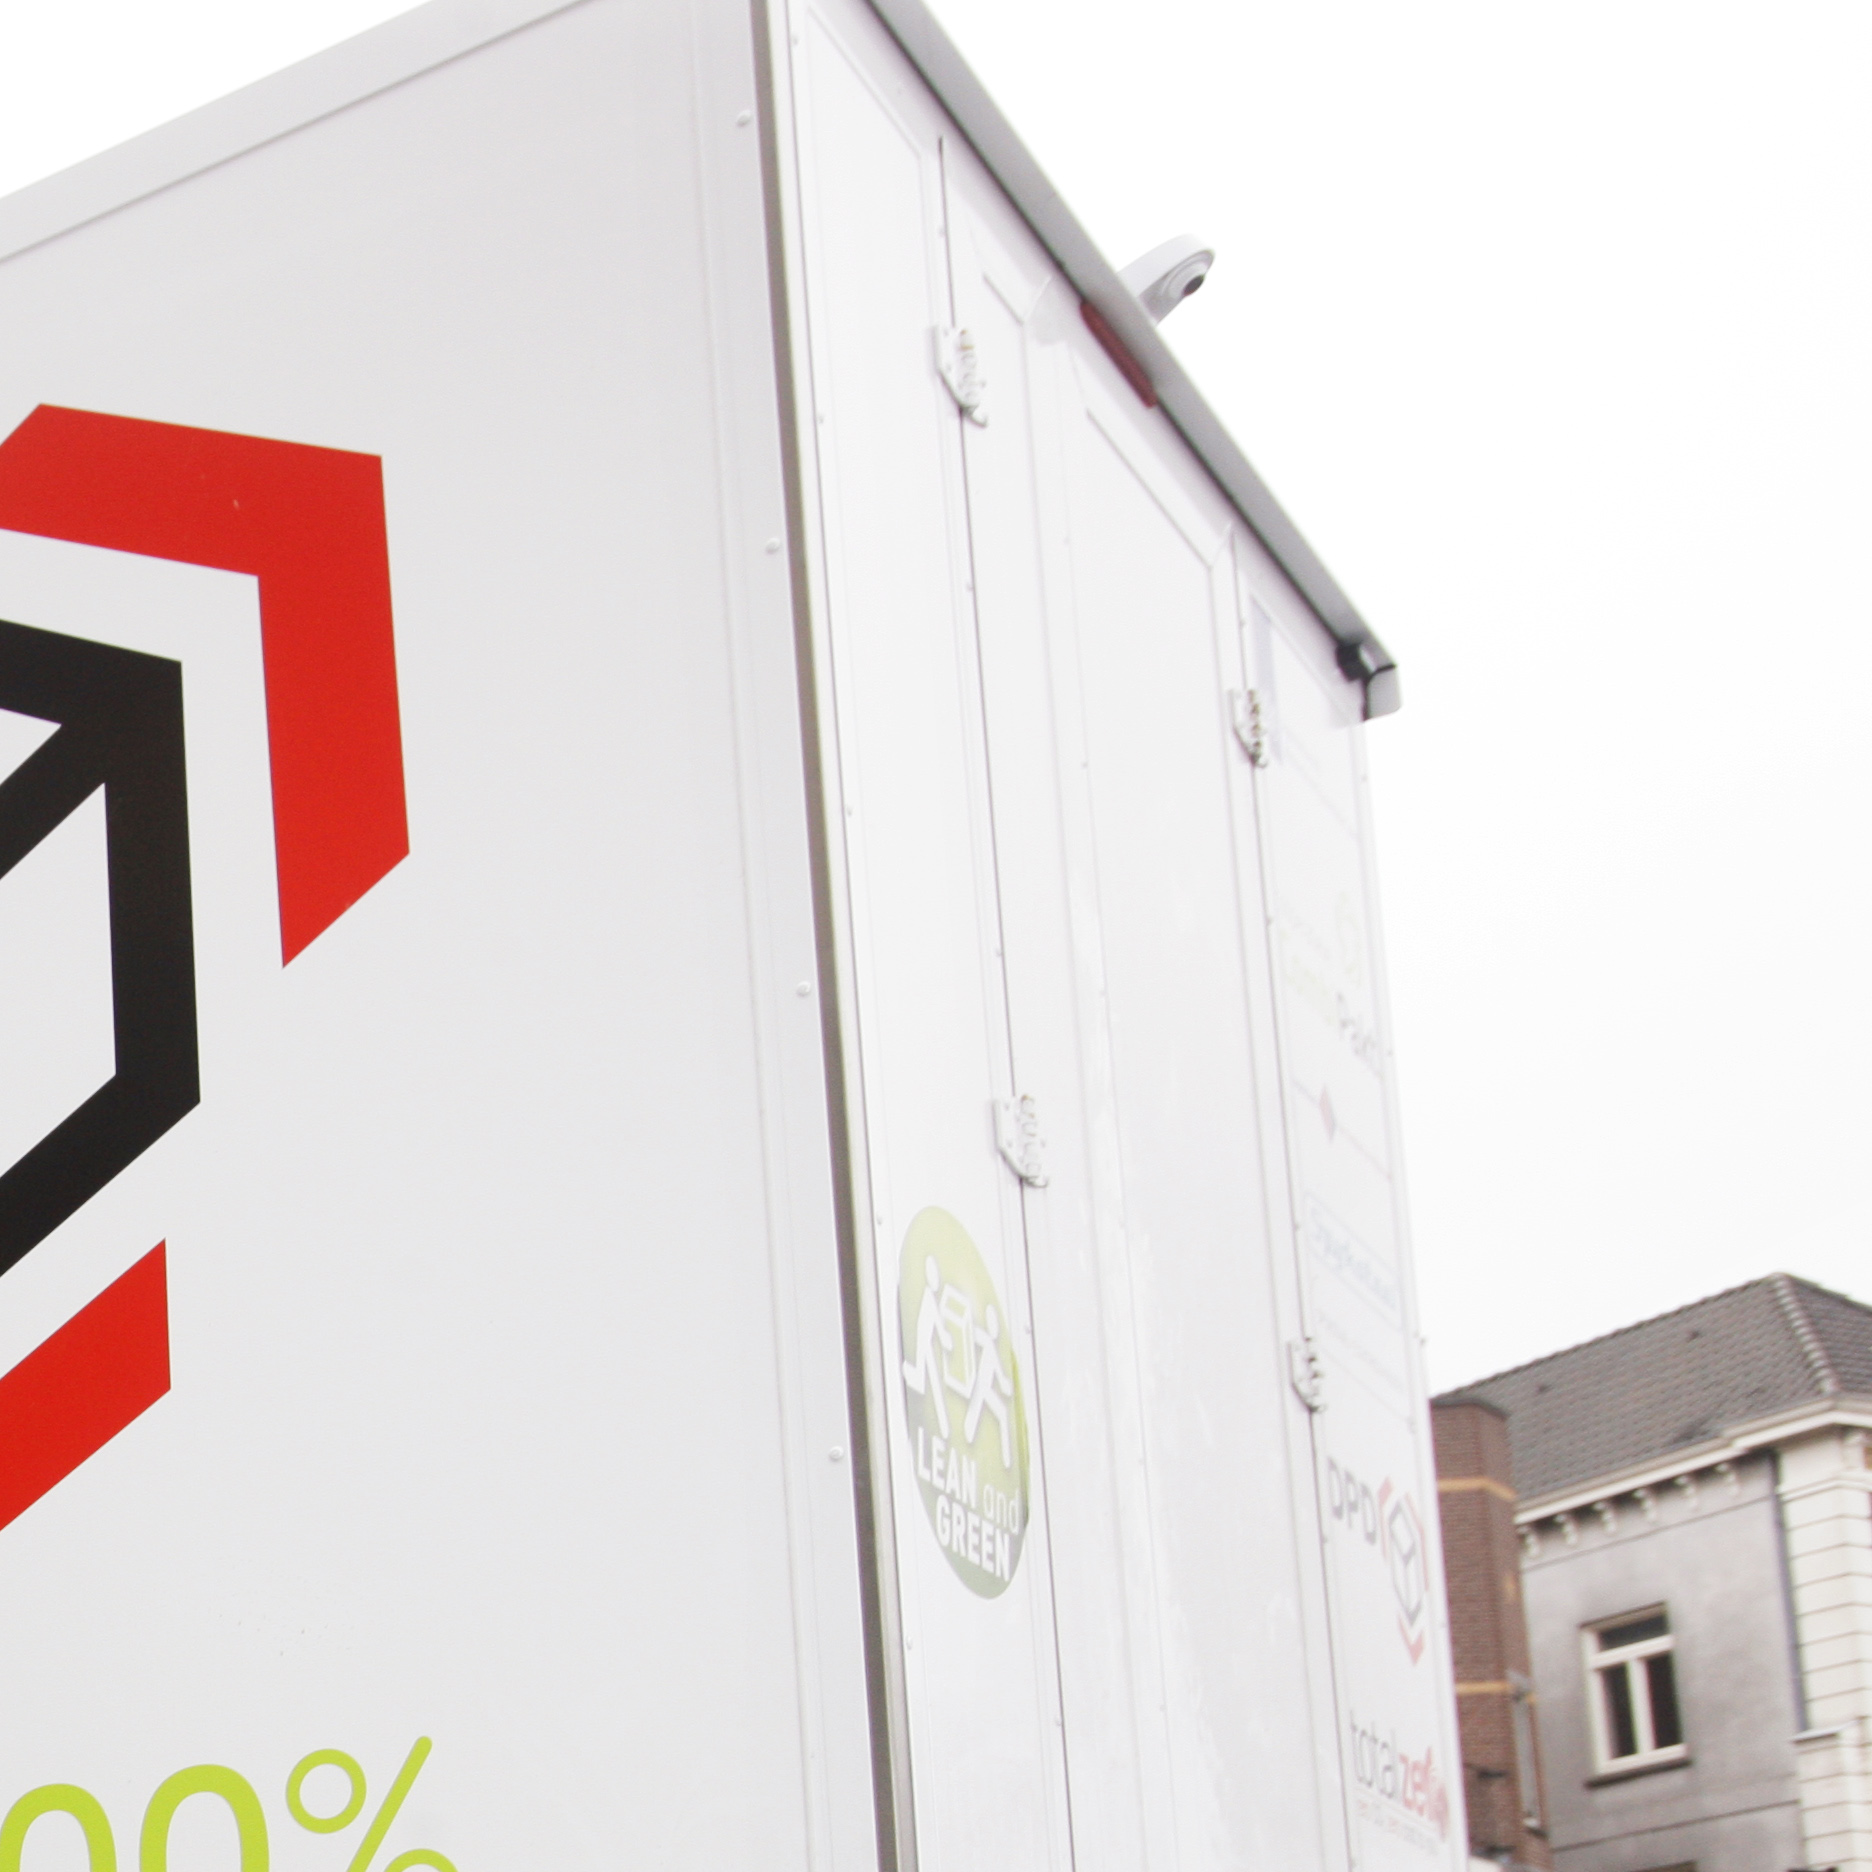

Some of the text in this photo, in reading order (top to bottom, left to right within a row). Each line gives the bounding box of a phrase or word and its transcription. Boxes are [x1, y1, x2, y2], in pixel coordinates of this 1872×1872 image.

[917, 1425, 1020, 1536] LEAN and
[1327, 1455, 1378, 1547] DPD
[936, 1494, 1011, 1583] GREEN
